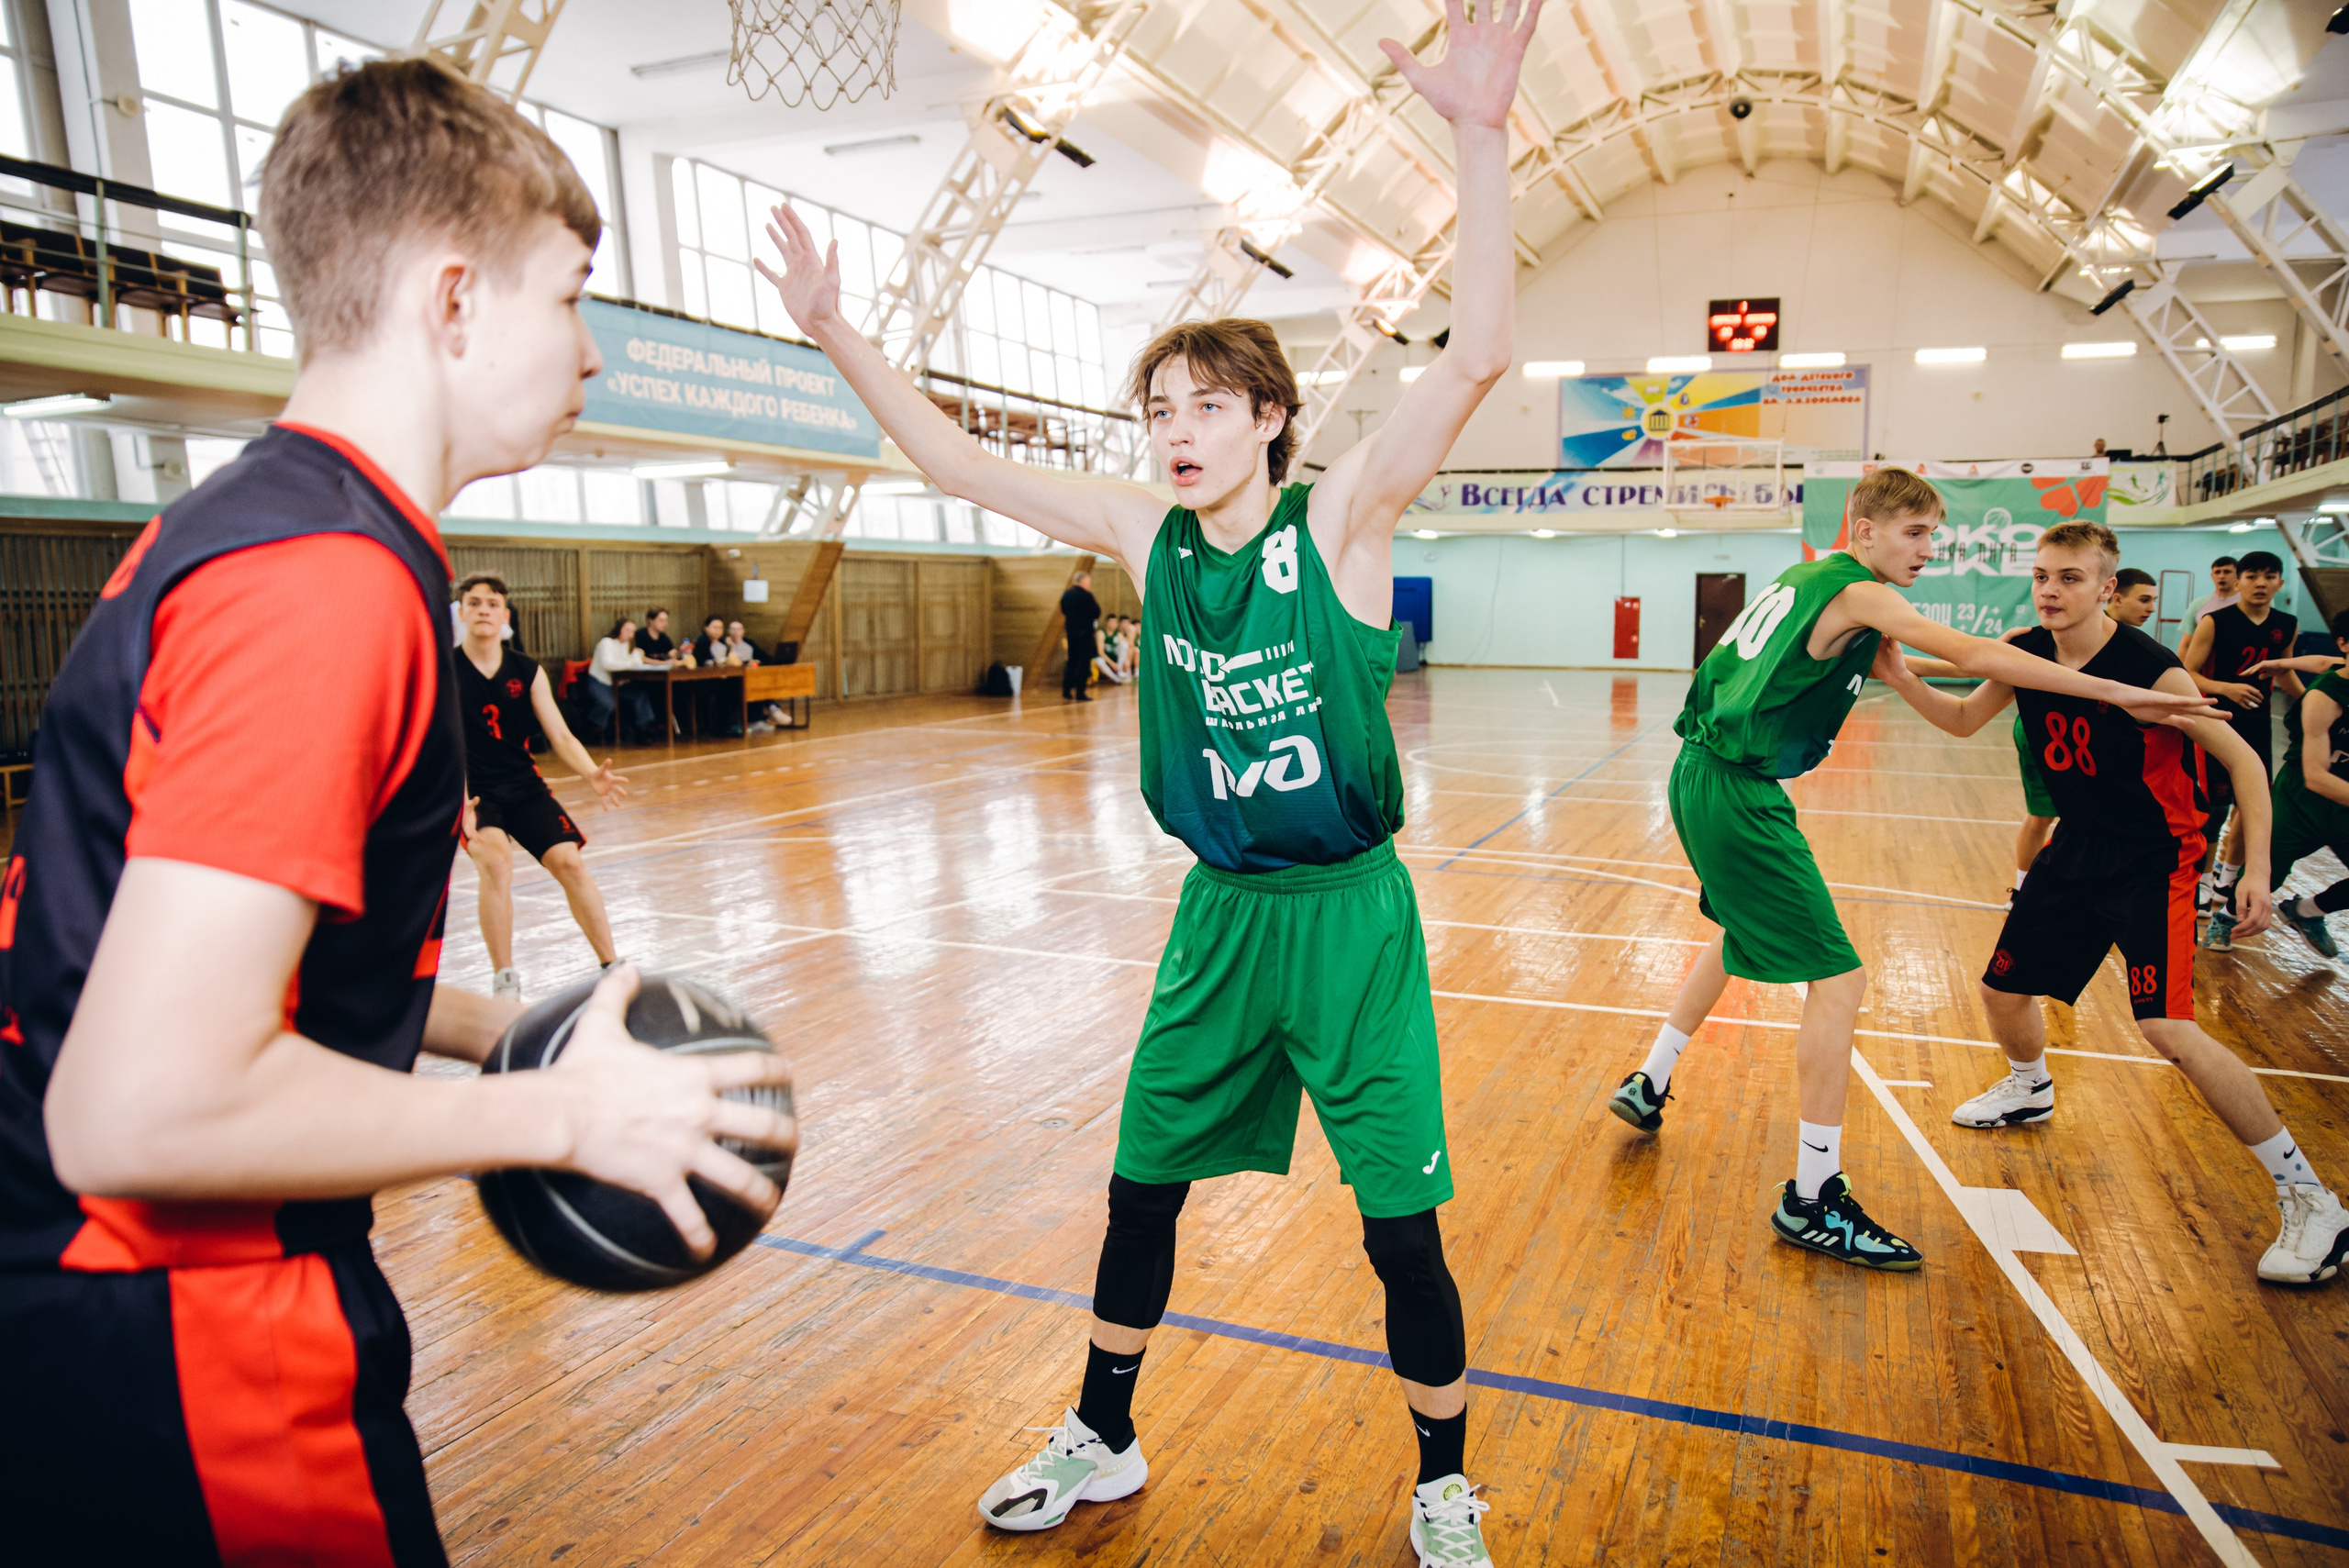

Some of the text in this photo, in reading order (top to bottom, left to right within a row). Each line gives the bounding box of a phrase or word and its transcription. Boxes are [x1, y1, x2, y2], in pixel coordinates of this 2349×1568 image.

[607, 370, 682, 404] «УСПЕХ
[685, 383, 779, 418] КАЖДОГО
[626, 337, 836, 397] ФЕДЕРАЛЬНЫЙ ПРОЕКТ
[1261, 524, 1297, 595] 8
[2043, 710, 2098, 777] 88
[2131, 964, 2158, 996] 88
